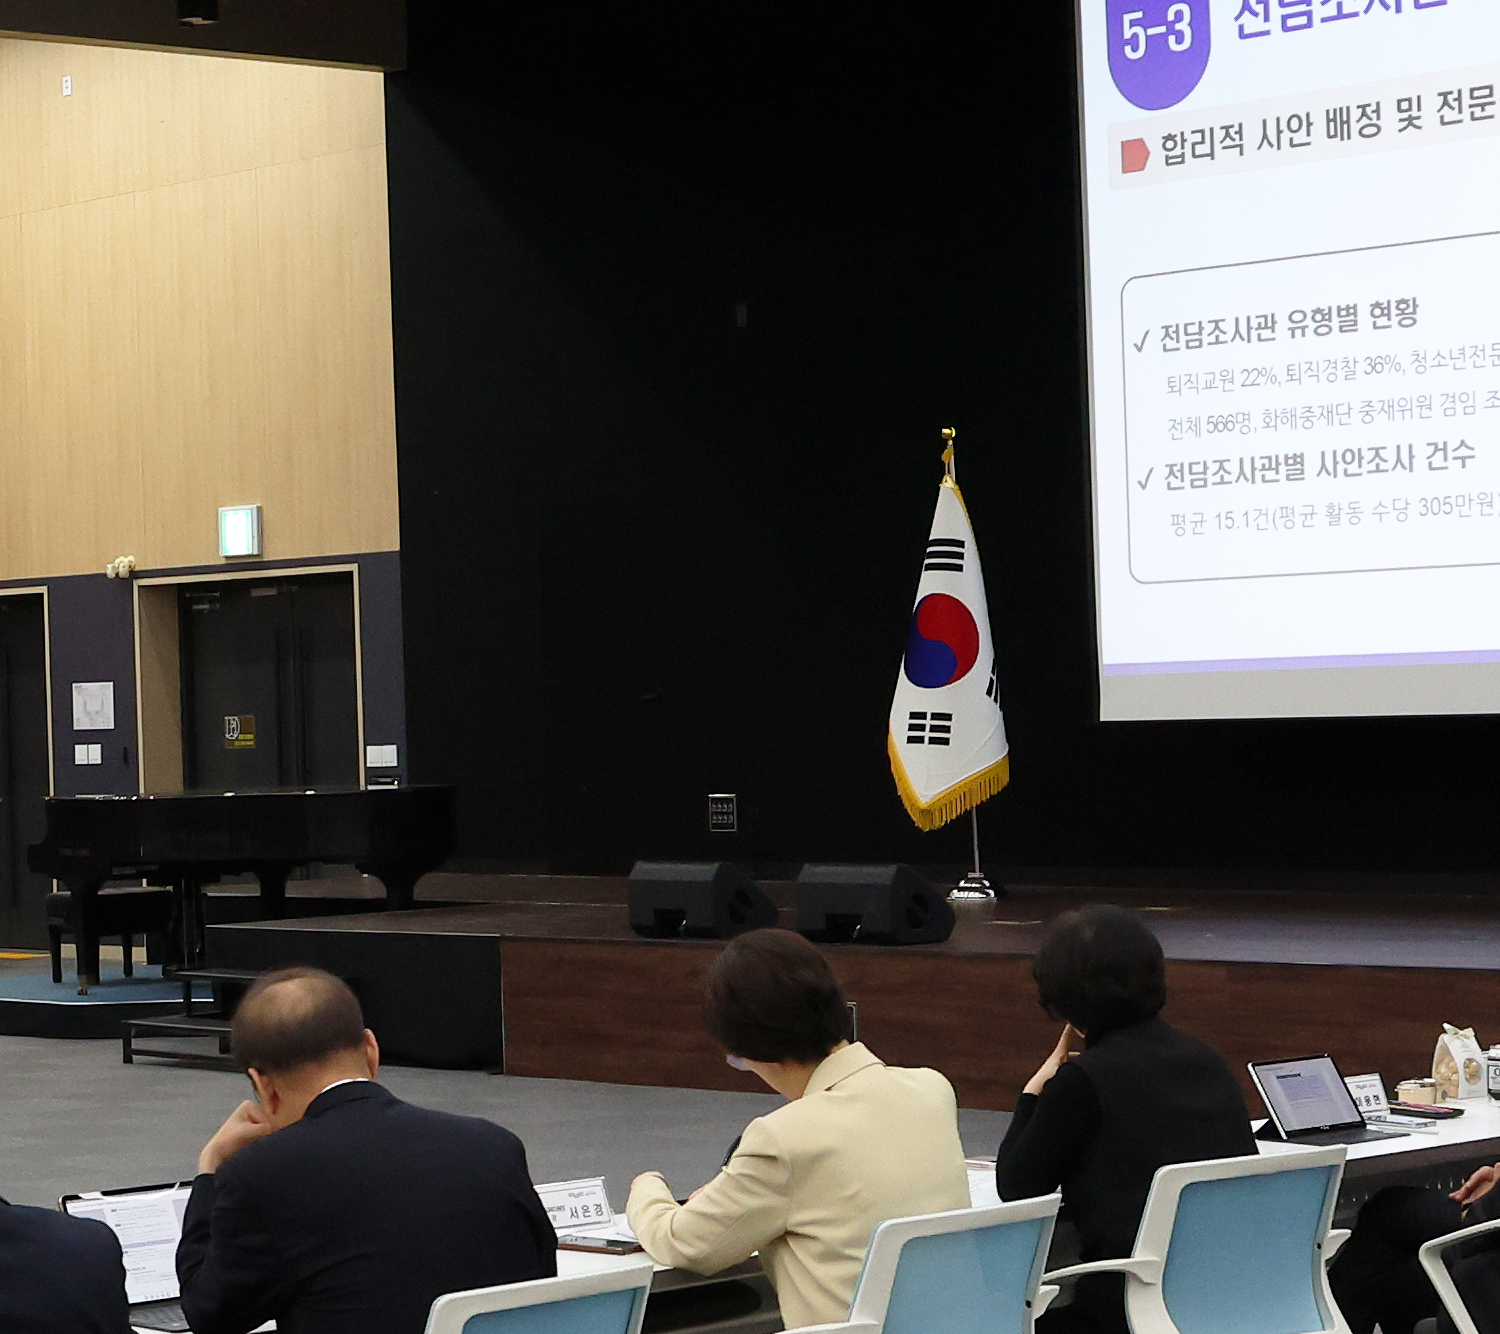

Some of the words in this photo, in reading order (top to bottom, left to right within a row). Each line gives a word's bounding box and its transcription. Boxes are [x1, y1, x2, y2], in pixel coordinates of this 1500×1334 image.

[1122, 2, 1193, 60] 5-3
[1161, 122, 1245, 167] 합리적
[1257, 112, 1314, 152] 사안
[1325, 100, 1382, 142] 배정
[1397, 94, 1424, 131] 및
[1160, 312, 1277, 353] 전담조사관
[1287, 303, 1359, 339] 유형별
[1369, 297, 1420, 329] 현황
[1167, 369, 1234, 396] 퇴직교원
[1240, 367, 1281, 388] 22%,
[1286, 356, 1358, 385] 퇴직경찰
[1363, 354, 1405, 375] 36%,
[1168, 416, 1201, 440] 전체
[1206, 410, 1257, 435] 566명,
[1262, 402, 1353, 432] 화해중재단
[1358, 394, 1432, 424] 중재위원
[1440, 390, 1476, 417] 겸임
[1165, 452, 1305, 491] 전담조사관별
[1317, 443, 1415, 478] 사안조사
[1426, 439, 1475, 471] 건수
[1170, 512, 1206, 537] 평균
[1215, 504, 1318, 531] 15.1건(평균
[1325, 501, 1364, 526] 활동
[1372, 498, 1411, 523] 수당
